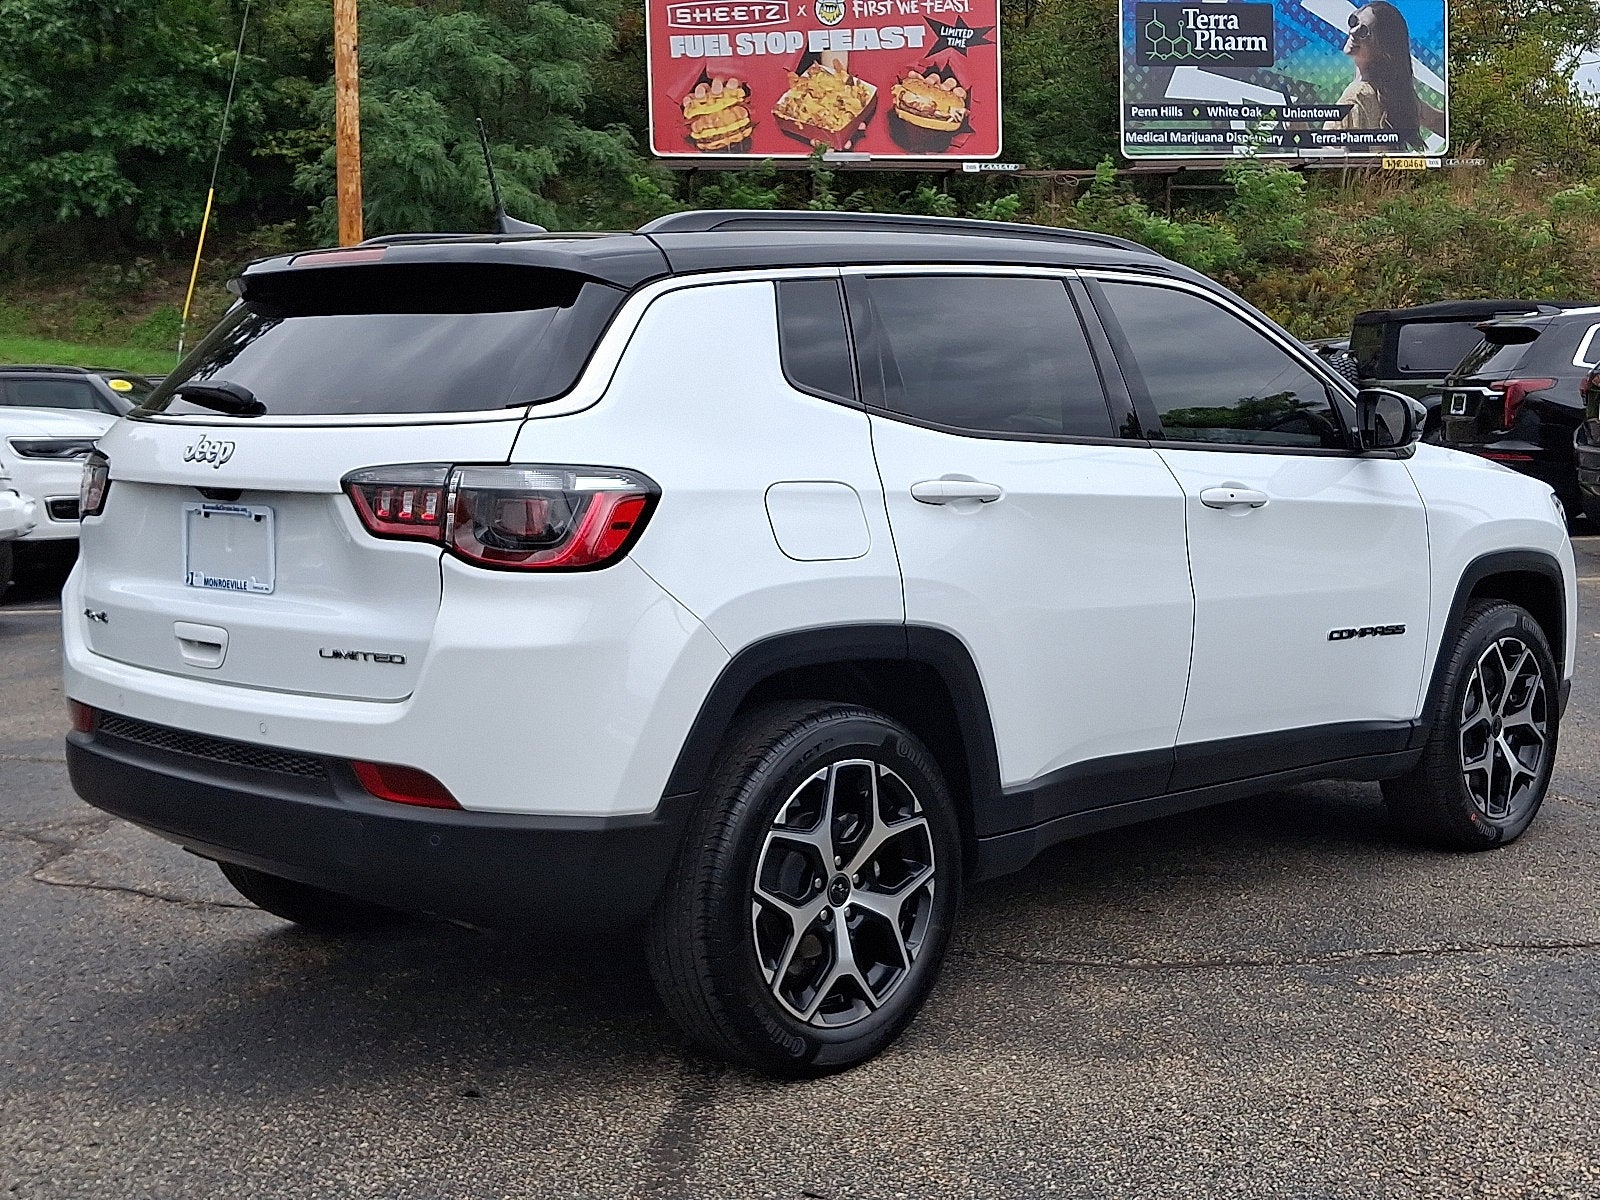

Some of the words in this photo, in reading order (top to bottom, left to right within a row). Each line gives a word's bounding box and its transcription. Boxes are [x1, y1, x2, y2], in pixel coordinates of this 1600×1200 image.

[676, 5, 781, 23] SHEETZ
[853, 0, 893, 19] FIRST
[895, 0, 919, 15] WE
[1182, 8, 1240, 30] Terra
[940, 25, 975, 39] LIMITED
[669, 33, 733, 58] FUEL
[735, 31, 804, 56] STOP
[807, 25, 926, 53] FEAST
[947, 37, 967, 48] TIME
[1194, 30, 1268, 52] Pharm
[1131, 106, 1158, 118] Penn
[1160, 106, 1183, 118] Hills
[1207, 106, 1239, 118] White
[1241, 106, 1262, 118] Oak
[1282, 107, 1340, 119] Uniontown
[1125, 132, 1168, 143] Medical
[1170, 132, 1222, 145] Marijuana
[1311, 132, 1399, 144] Terra-Pharm.com
[183, 434, 236, 469] Jeep
[203, 577, 248, 591] MONROEVILLE
[1328, 624, 1407, 641] COMPASS
[319, 648, 406, 665] LIMITED
